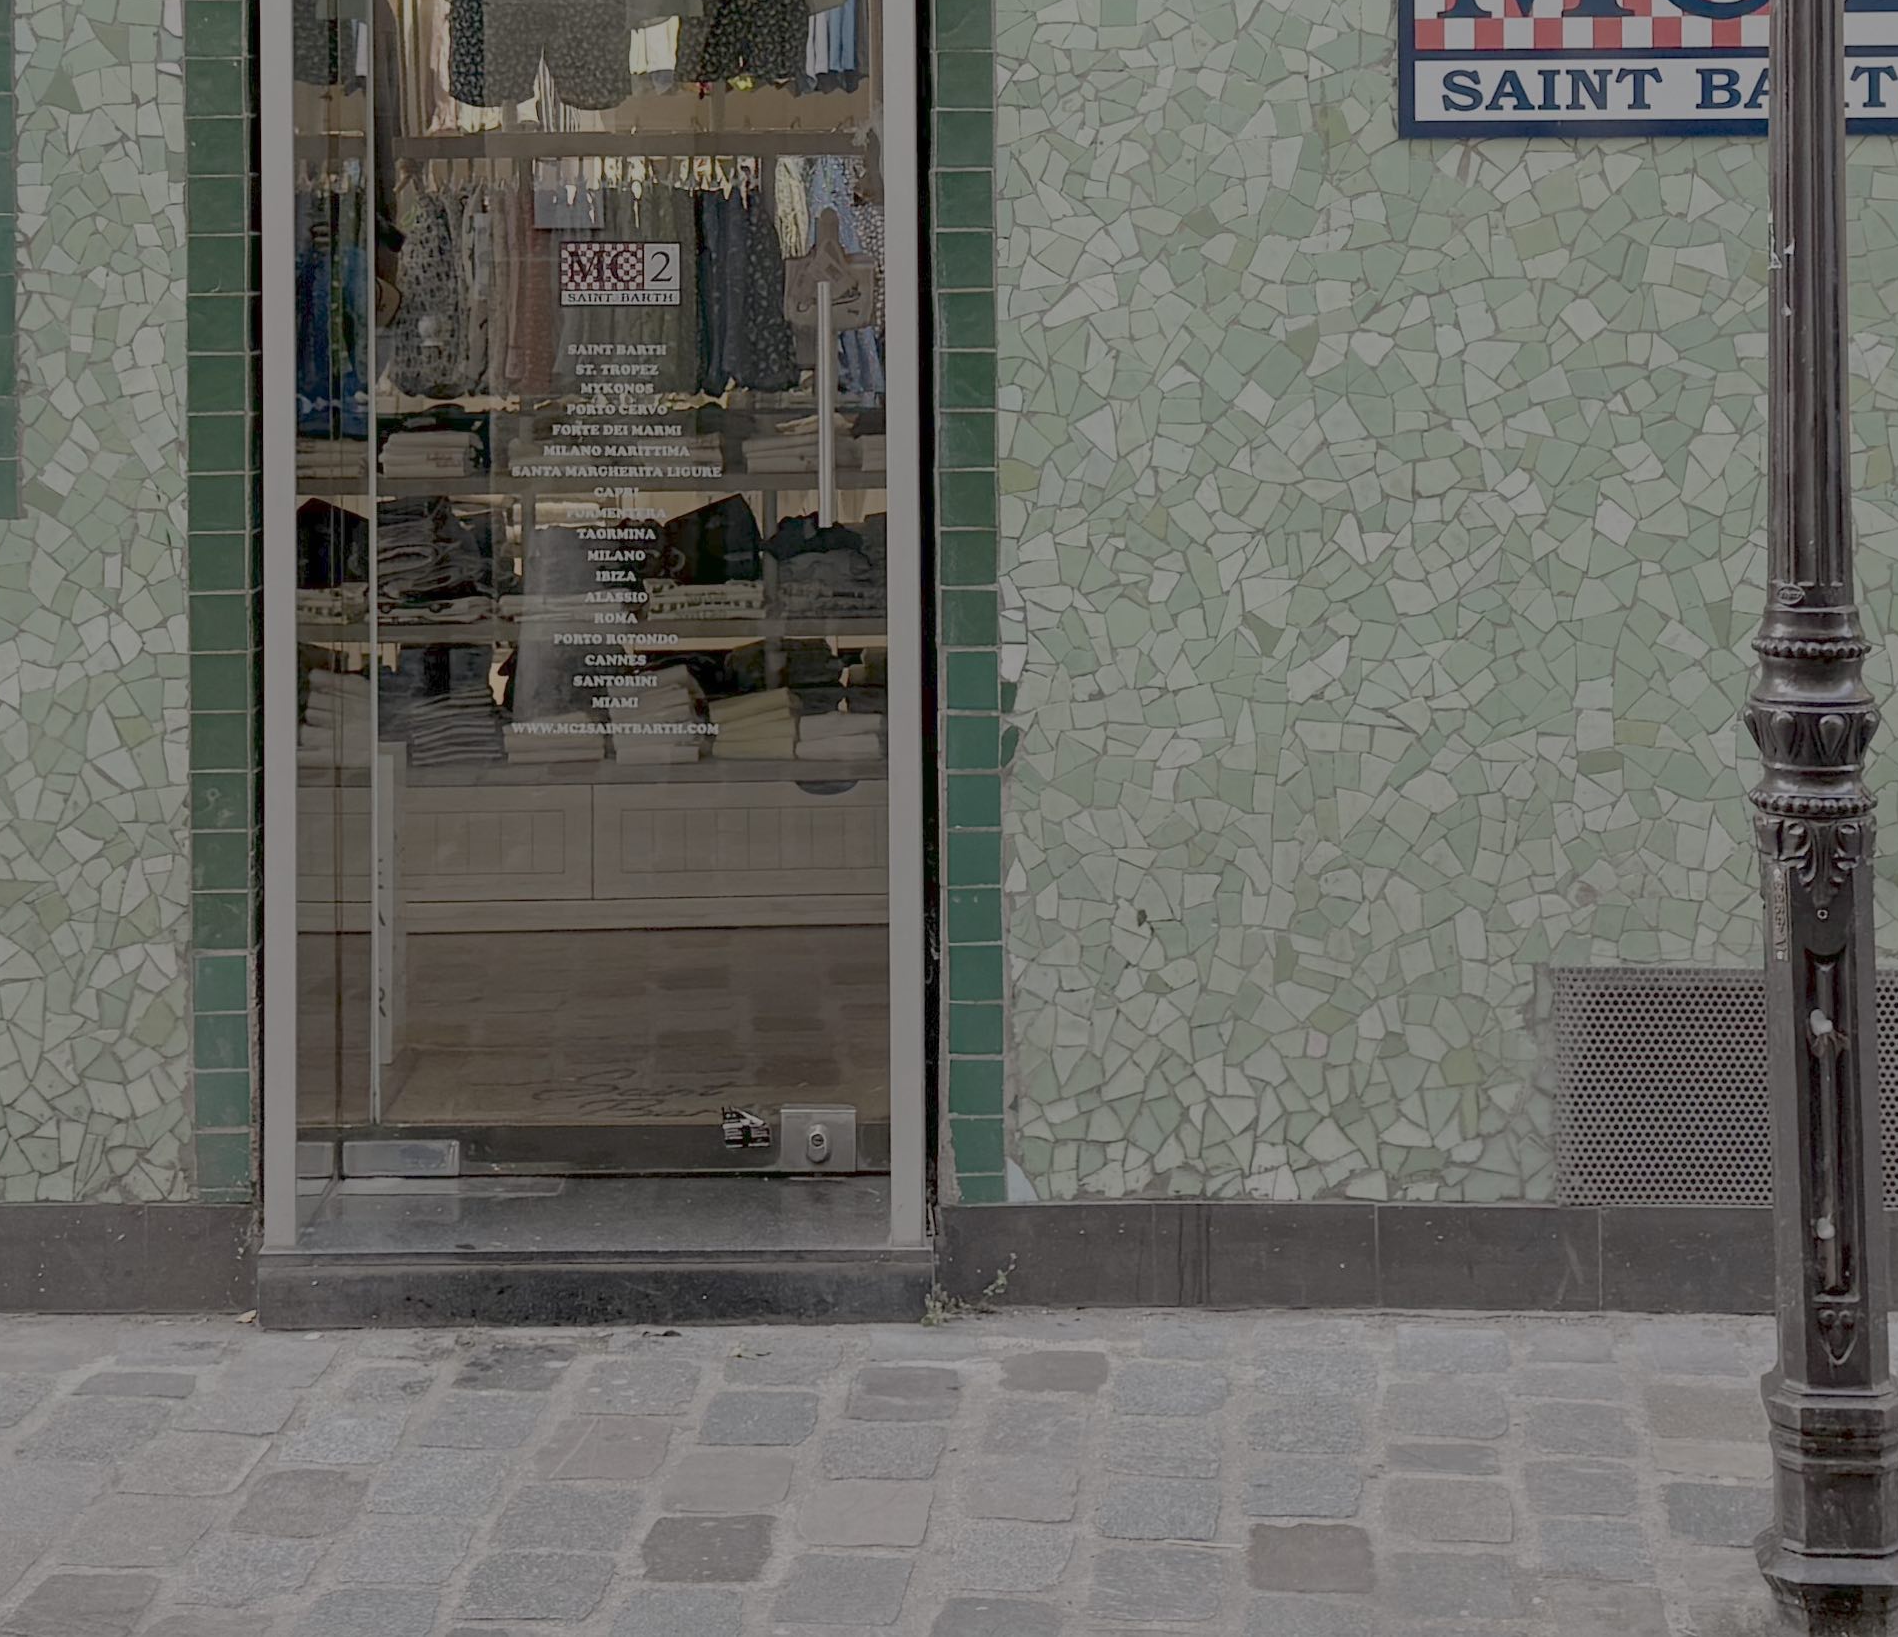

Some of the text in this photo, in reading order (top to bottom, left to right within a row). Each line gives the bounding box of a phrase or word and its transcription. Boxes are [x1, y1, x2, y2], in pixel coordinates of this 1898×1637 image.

[1442, 67, 1663, 111] SAINT
[567, 293, 674, 303] SAINT BARTH
[567, 344, 667, 356] SAINT BARTH
[575, 364, 659, 376] ST. TROPEZ
[580, 383, 654, 394] MYKONOS
[566, 404, 668, 415] PORTO CERVO
[552, 424, 682, 436] FORTE DEI MARMI
[543, 445, 690, 457] MILANO MARITTIMA
[511, 466, 722, 478] SANTA MARGHERITA LIGURE
[593, 487, 639, 498] CAPRI
[576, 528, 656, 540] TAORMINA
[587, 550, 646, 562] MILANO
[595, 570, 636, 582] IBIZA
[584, 591, 649, 603] ALASSIO
[594, 613, 638, 624] ROMA
[553, 633, 679, 645] PORTO ROTONDO
[584, 654, 647, 666] CANNES
[572, 675, 658, 687] SANTORINI
[591, 696, 639, 708] MIAMI
[512, 722, 719, 736] WWW.MC2SAINTBARTH.COM
